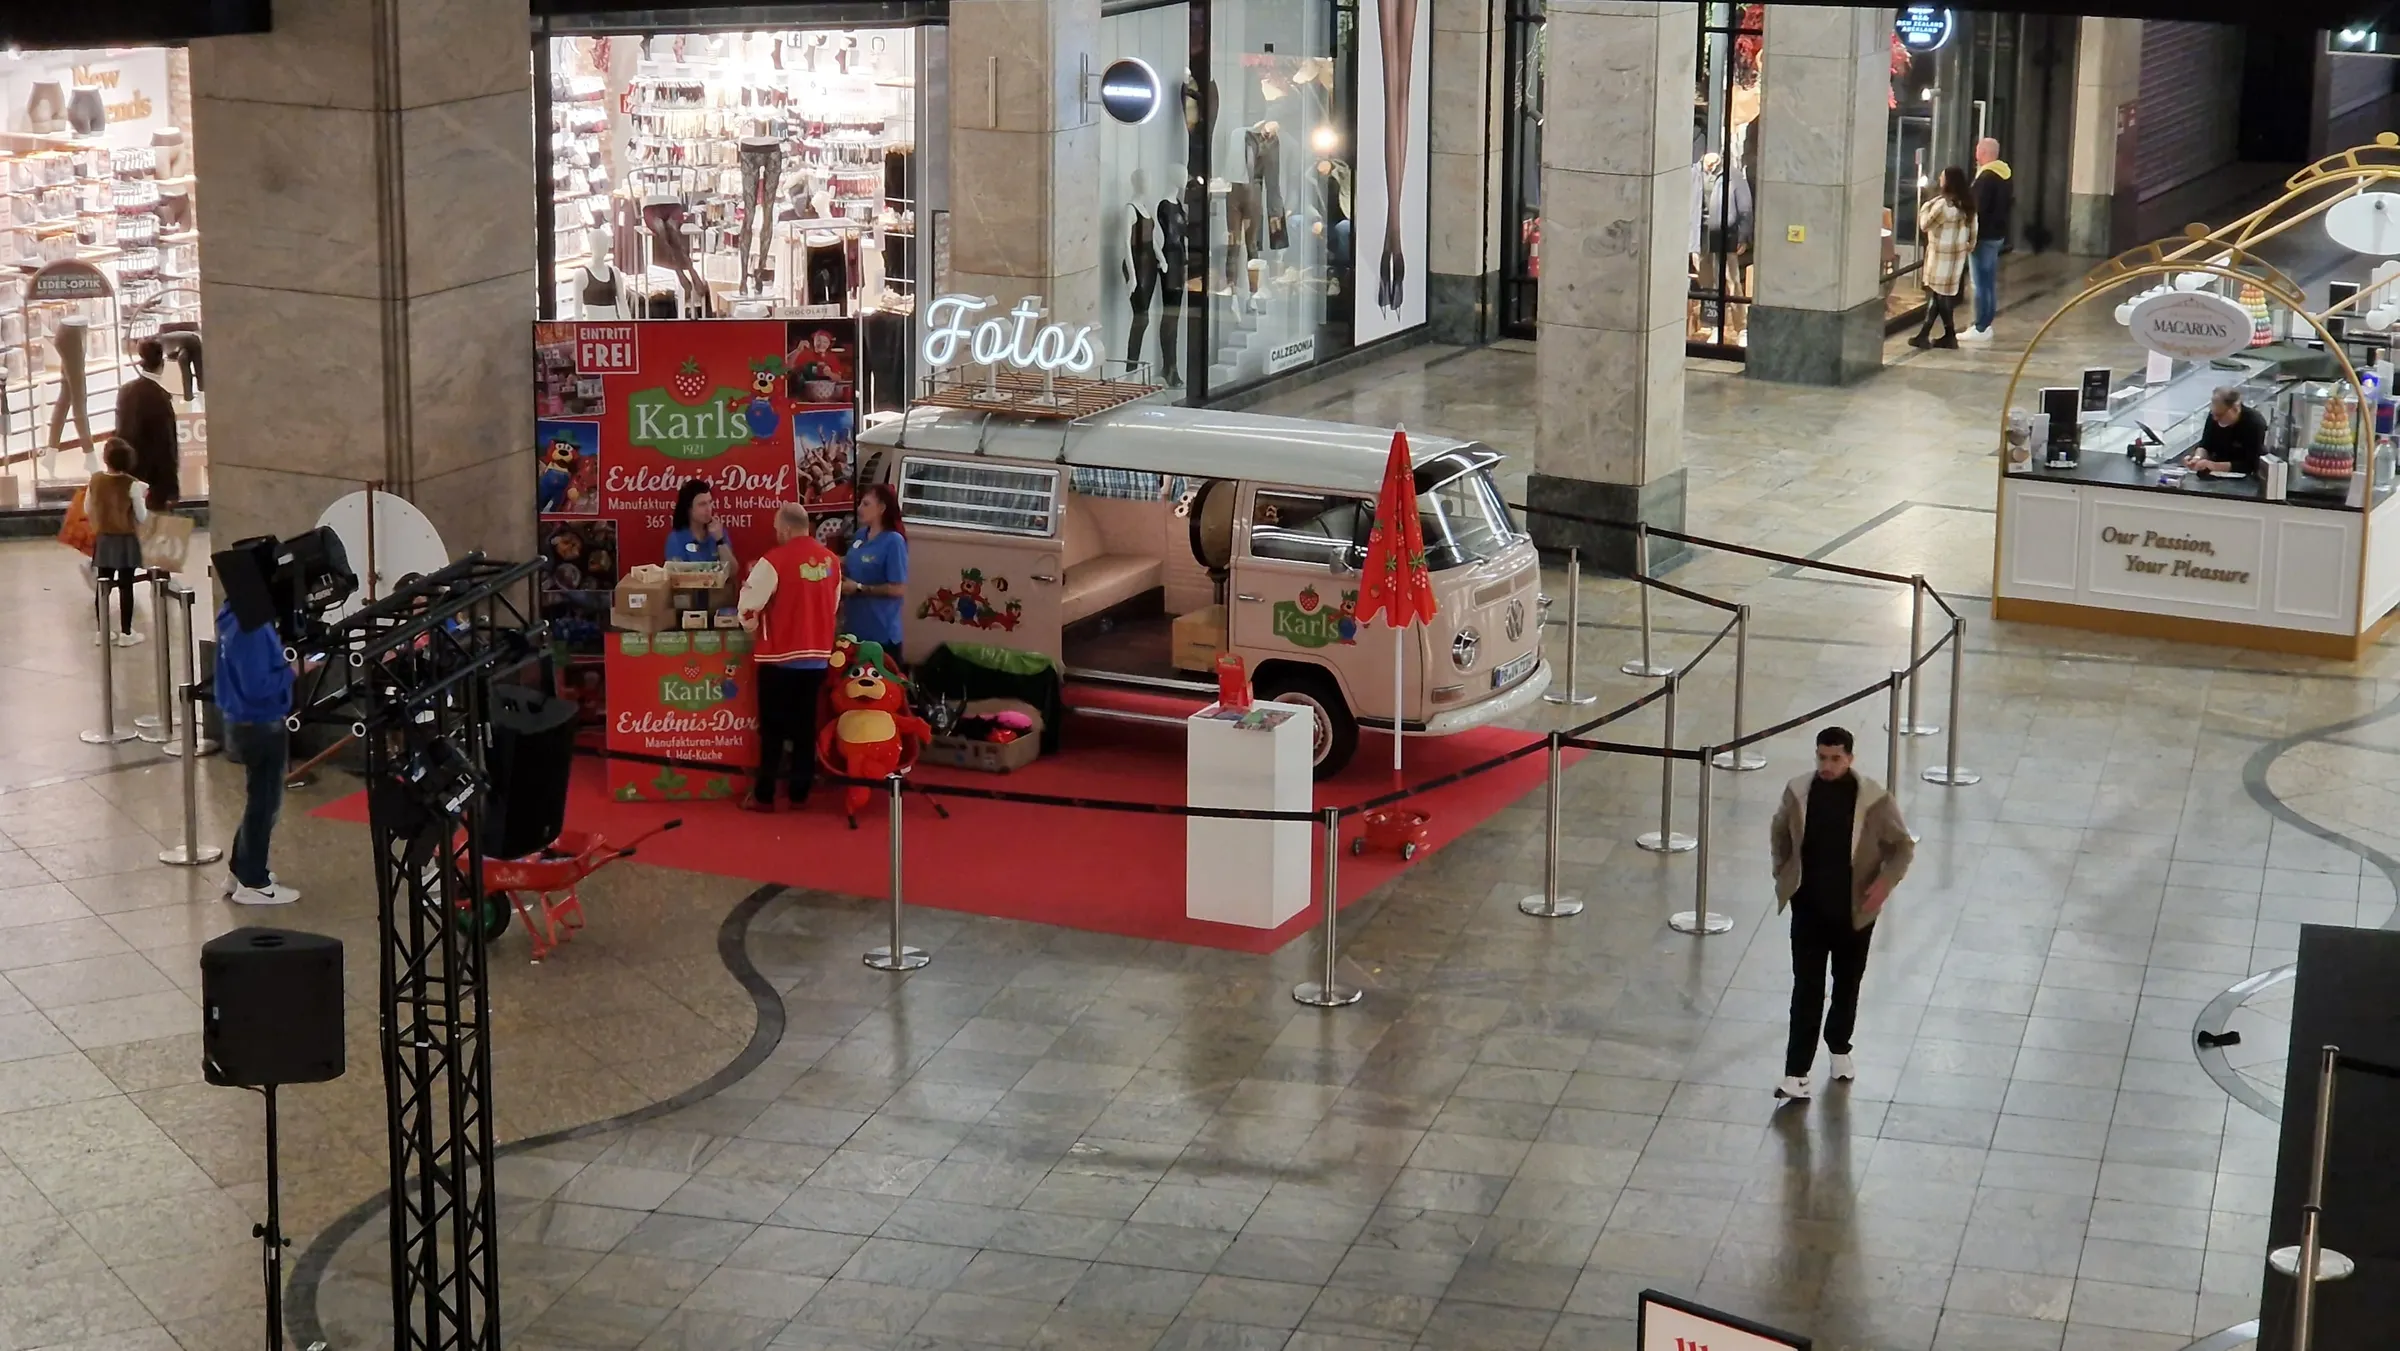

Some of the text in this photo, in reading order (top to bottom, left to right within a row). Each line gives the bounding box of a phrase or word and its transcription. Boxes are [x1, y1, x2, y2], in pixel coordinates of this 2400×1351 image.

[37, 280, 101, 289] LEDER-OPTIK
[580, 327, 632, 340] EINTRITT
[923, 296, 1095, 373] Fotos
[2154, 319, 2227, 338] MACARONS
[582, 343, 631, 368] FREI
[1271, 338, 1313, 361] CALZEDONIA
[635, 400, 748, 439] Karls
[682, 444, 705, 455] 1921
[723, 496, 732, 509] &
[646, 515, 665, 529] 365
[2102, 526, 2215, 557] Our Passion,
[2125, 554, 2251, 584] Your Pleasure
[1277, 610, 1340, 638] Karls
[663, 679, 724, 701] Karls
[616, 709, 759, 733] Erlebnis-Dor
[645, 735, 743, 748] Manufakturen-Markt
[675, 749, 723, 760] Hof-Küche
